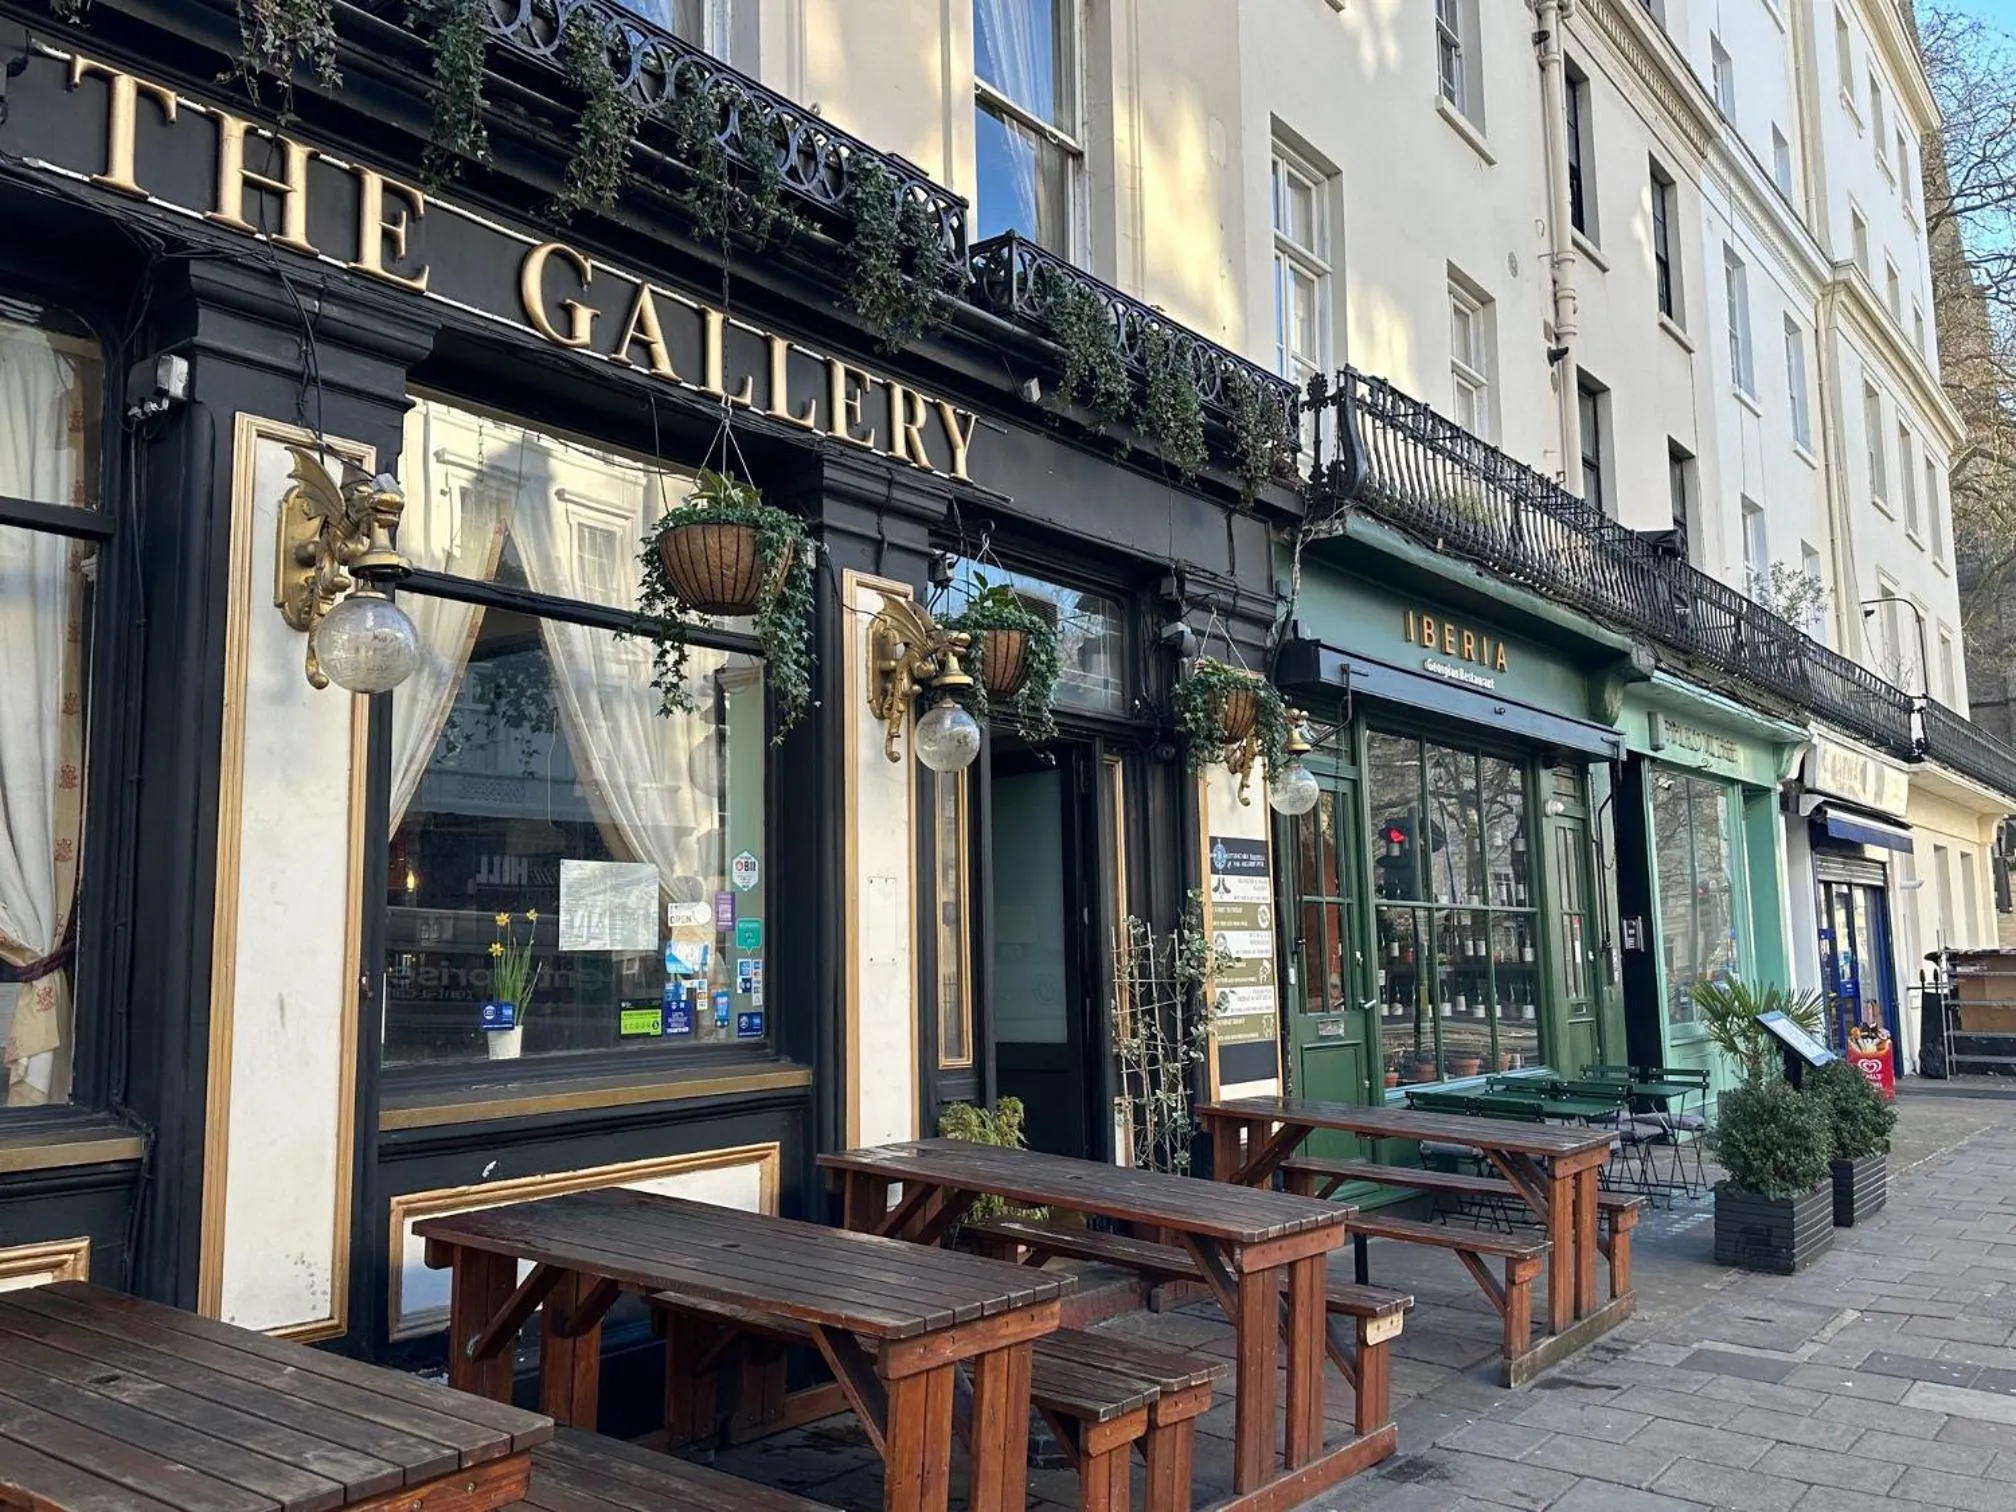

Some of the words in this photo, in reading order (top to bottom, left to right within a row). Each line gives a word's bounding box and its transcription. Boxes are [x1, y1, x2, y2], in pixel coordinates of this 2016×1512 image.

[68, 52, 428, 293] THE
[520, 242, 979, 483] GALLERY
[1405, 609, 1509, 672] IBERIA
